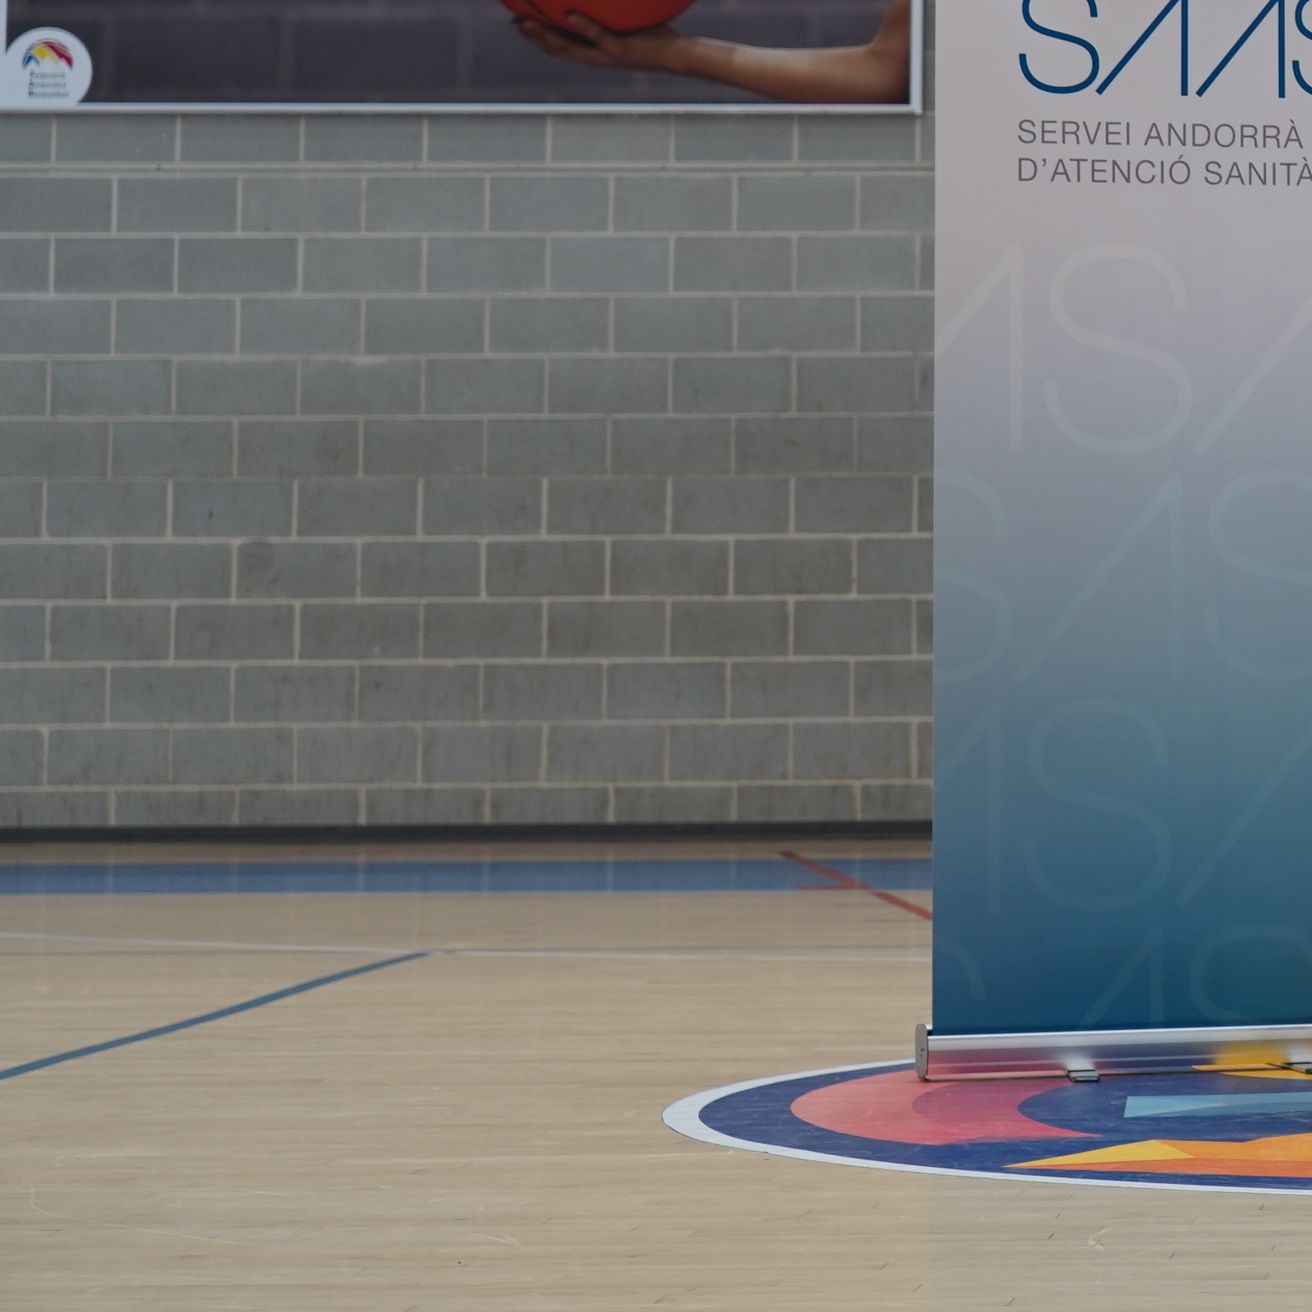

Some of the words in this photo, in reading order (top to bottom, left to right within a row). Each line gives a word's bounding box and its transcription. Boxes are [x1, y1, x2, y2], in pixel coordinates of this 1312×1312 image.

[1017, 119, 1132, 146] SERVEI
[1143, 119, 1304, 149] ANDORRÀ
[1017, 155, 1192, 185] D'ATENCIÓ
